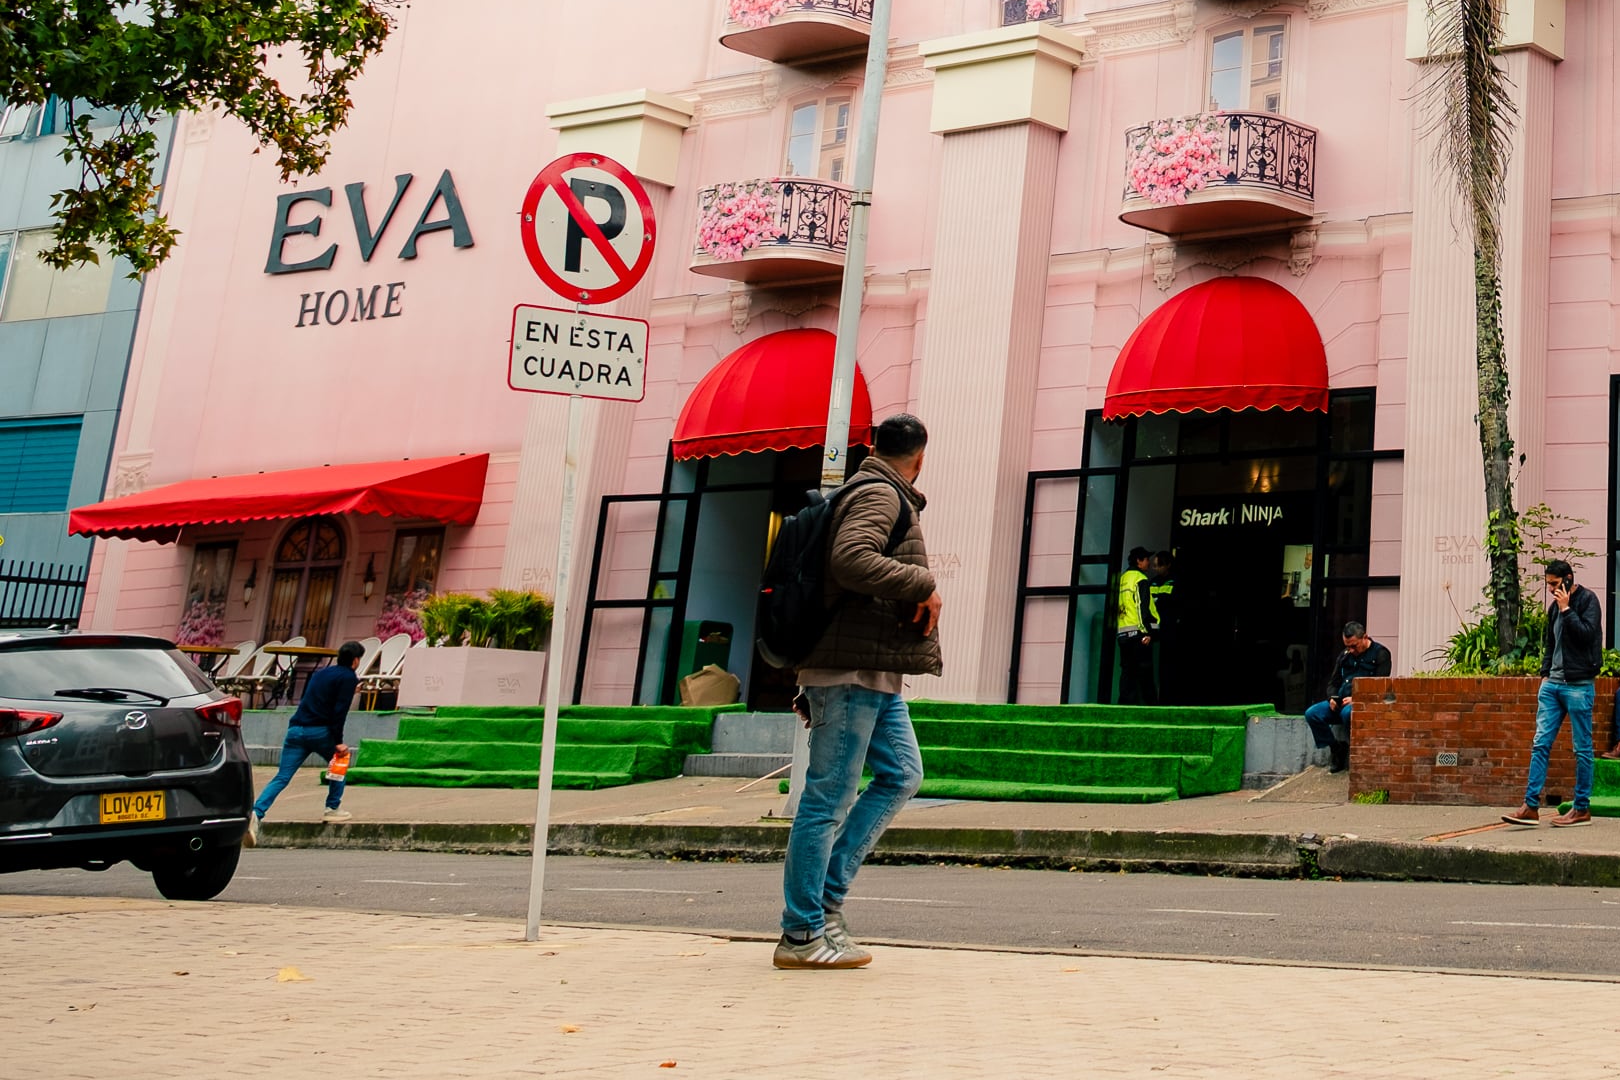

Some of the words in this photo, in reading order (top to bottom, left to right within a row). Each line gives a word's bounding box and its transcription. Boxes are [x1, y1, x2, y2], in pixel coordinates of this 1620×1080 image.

[264, 169, 474, 274] EVA
[295, 282, 406, 328] HOME
[525, 320, 559, 344] EN
[523, 355, 632, 387] CUADRA
[1180, 508, 1230, 526] Shark
[1241, 503, 1283, 526] NINJA
[1433, 535, 1482, 552] EVA
[1441, 554, 1474, 564] HOME
[521, 568, 551, 581] EVA
